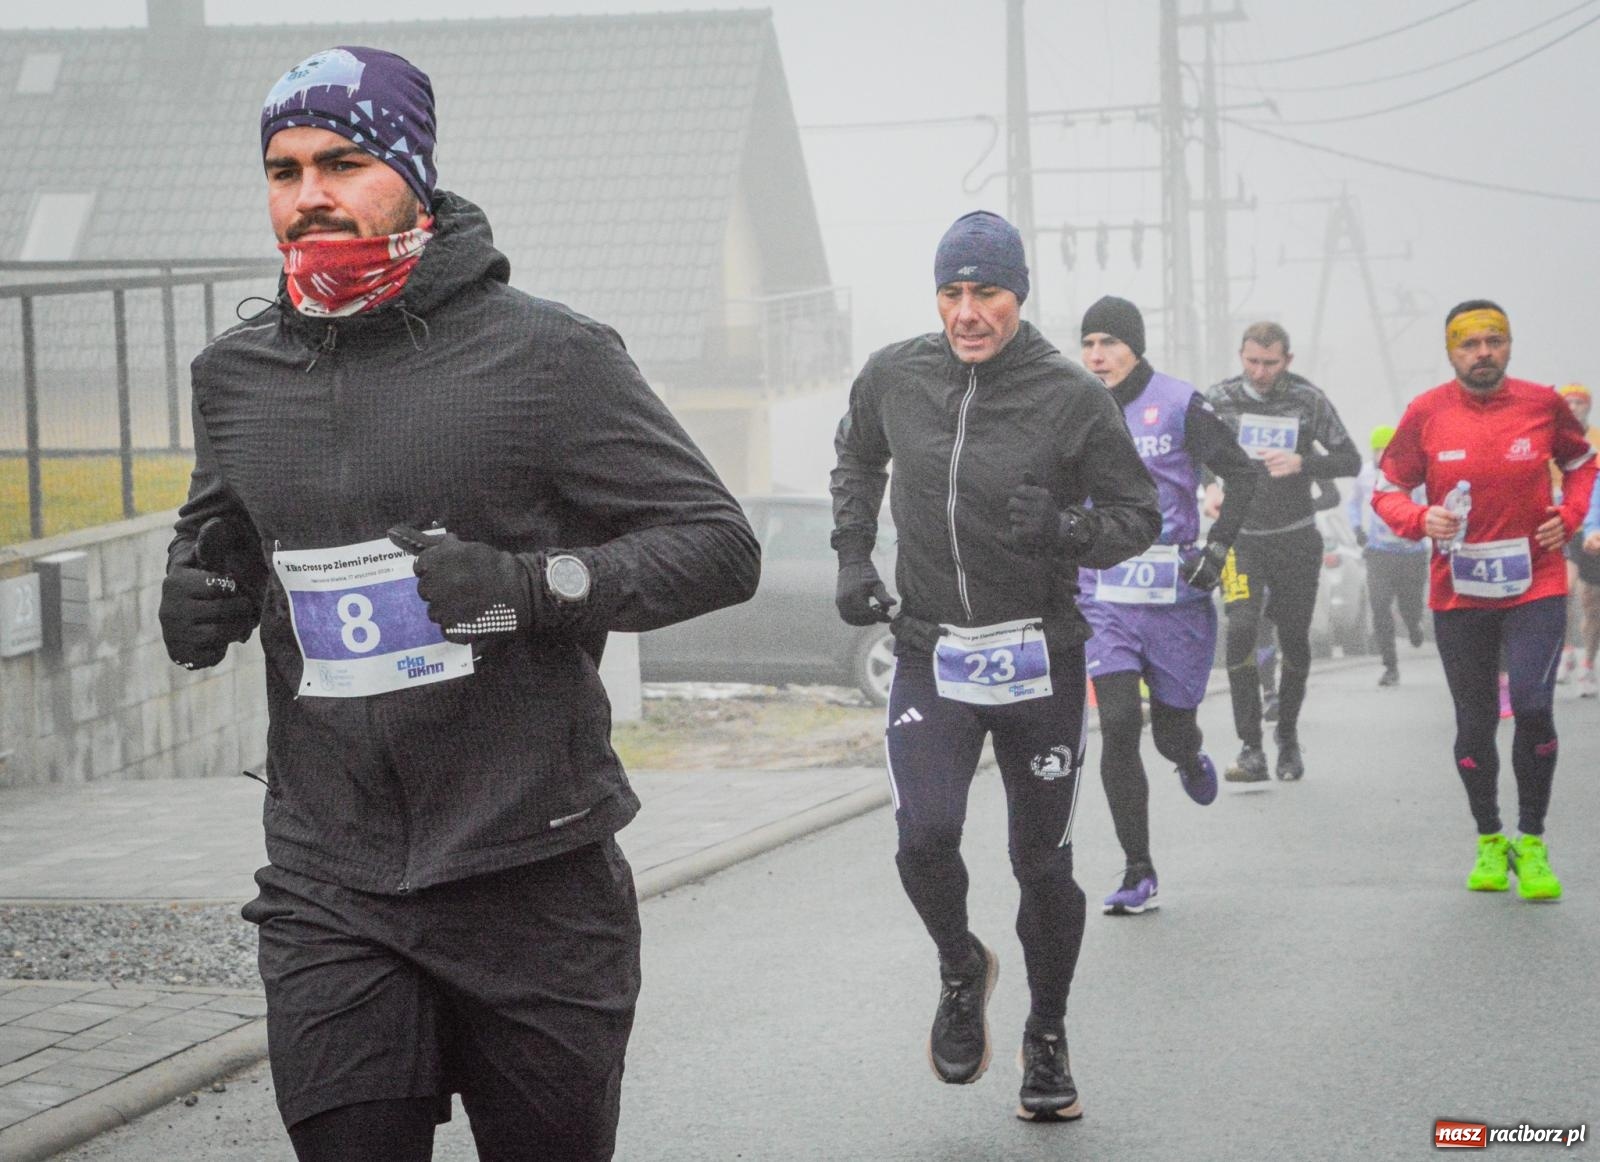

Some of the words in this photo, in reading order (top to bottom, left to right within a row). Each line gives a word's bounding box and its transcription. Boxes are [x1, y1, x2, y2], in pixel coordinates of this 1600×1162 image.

[1250, 427, 1287, 448] 154
[302, 563, 322, 571] Cross
[323, 562, 333, 573] po
[334, 556, 361, 569] Ziemi
[1119, 562, 1156, 587] 70
[1472, 558, 1507, 582] 41
[337, 593, 381, 653] 8
[964, 649, 1016, 684] 23
